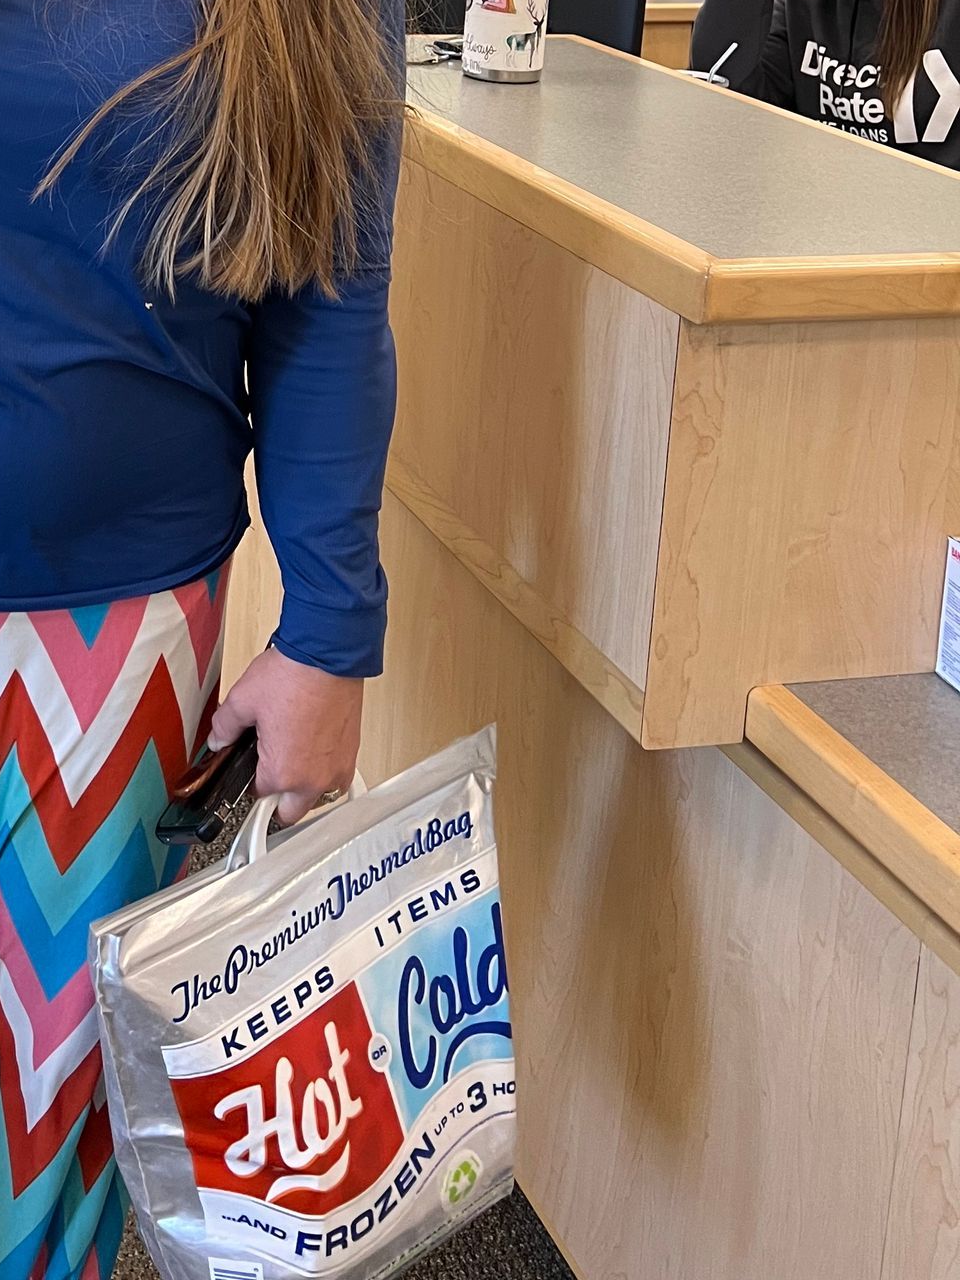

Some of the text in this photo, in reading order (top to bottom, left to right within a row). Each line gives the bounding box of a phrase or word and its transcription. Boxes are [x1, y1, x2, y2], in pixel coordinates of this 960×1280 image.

[820, 83, 885, 124] Rate
[172, 810, 474, 1023] The Premium Thermal Bag
[221, 868, 482, 1058] KEEPS ITEMS
[397, 902, 513, 1091] Cold
[213, 1020, 363, 1180] Hot
[371, 1045, 387, 1062] OR
[294, 1131, 437, 1258] FROZEN
[433, 1116, 448, 1136] UP
[449, 1102, 465, 1118] TO
[466, 1081, 488, 1113] 3
